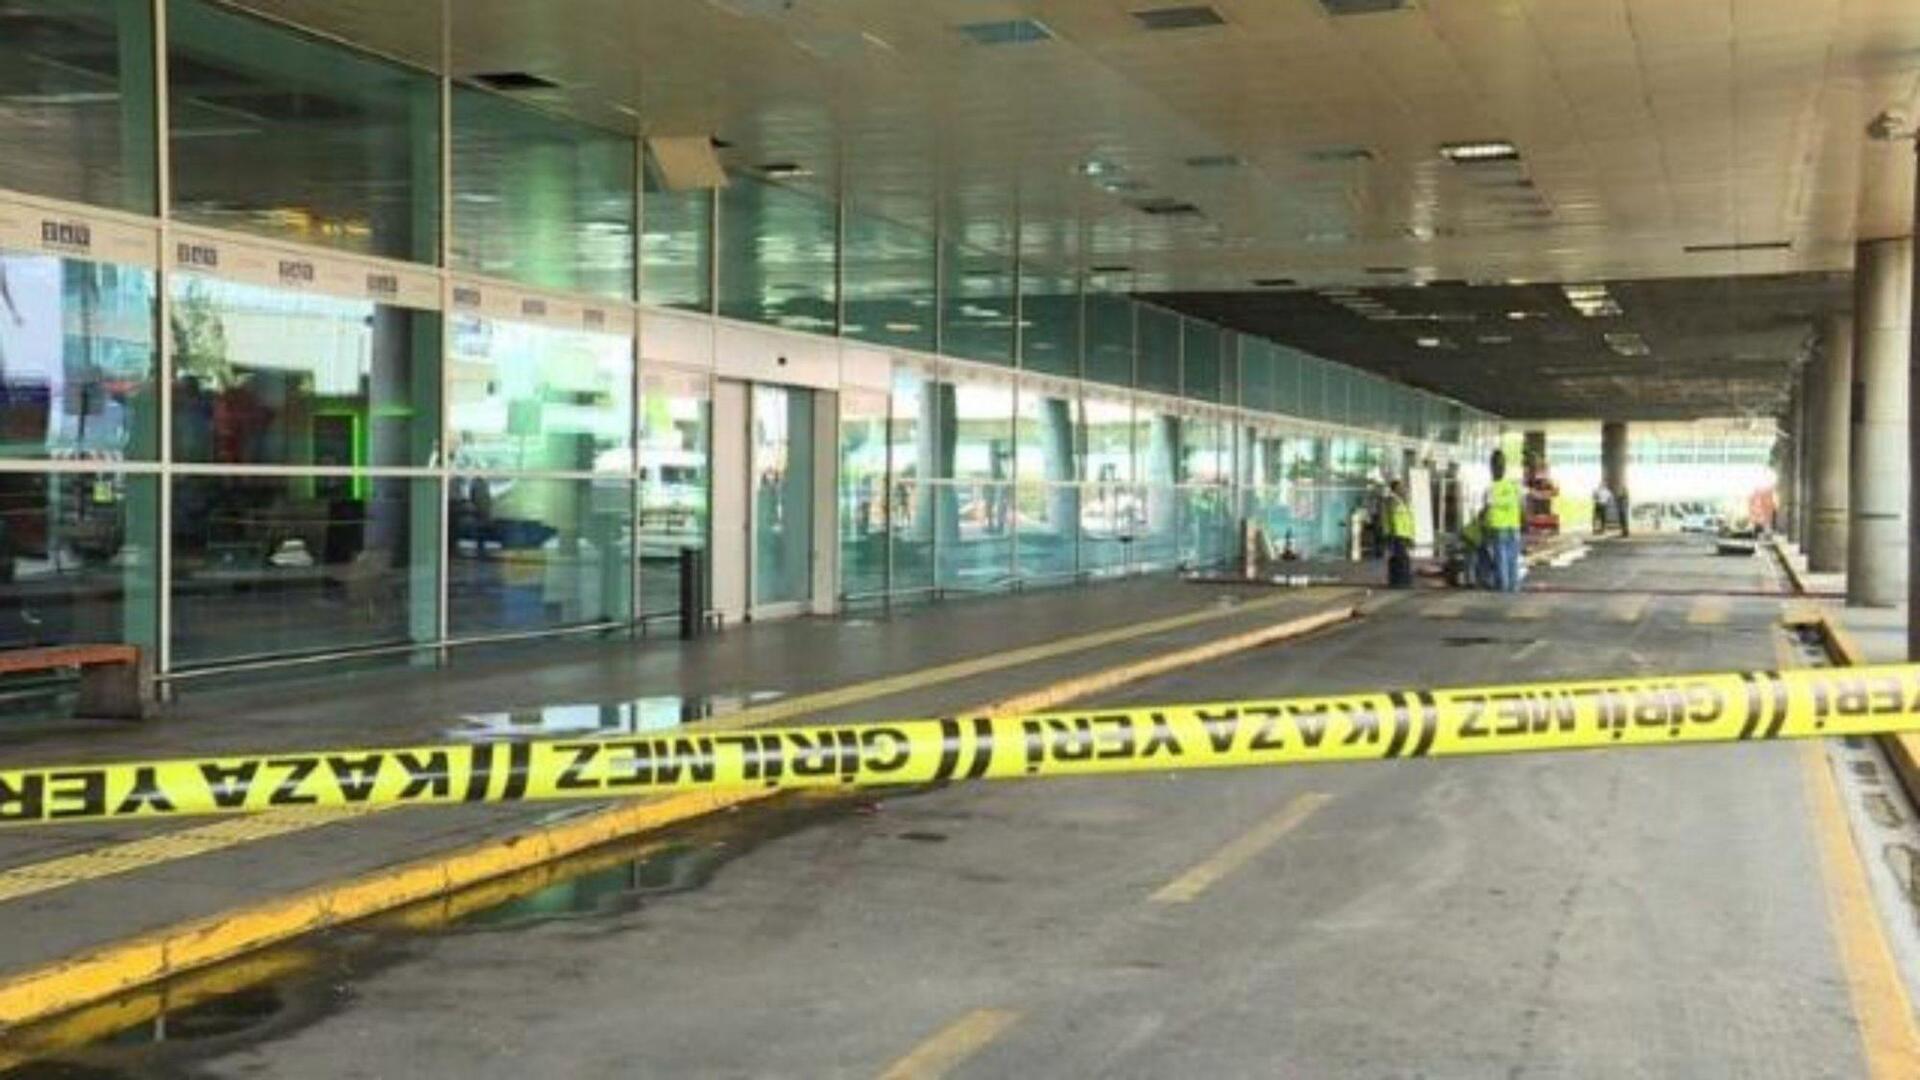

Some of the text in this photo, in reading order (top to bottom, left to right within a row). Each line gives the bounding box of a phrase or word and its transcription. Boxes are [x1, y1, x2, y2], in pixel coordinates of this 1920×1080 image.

[1196, 700, 1380, 752] KAZA
[1451, 683, 1725, 739] GİRİLMEZ
[1814, 677, 1920, 729] ERİ
[552, 727, 912, 790] GİRİLMEZ
[1021, 712, 1184, 772] YERİ
[199, 750, 450, 809] KAZA
